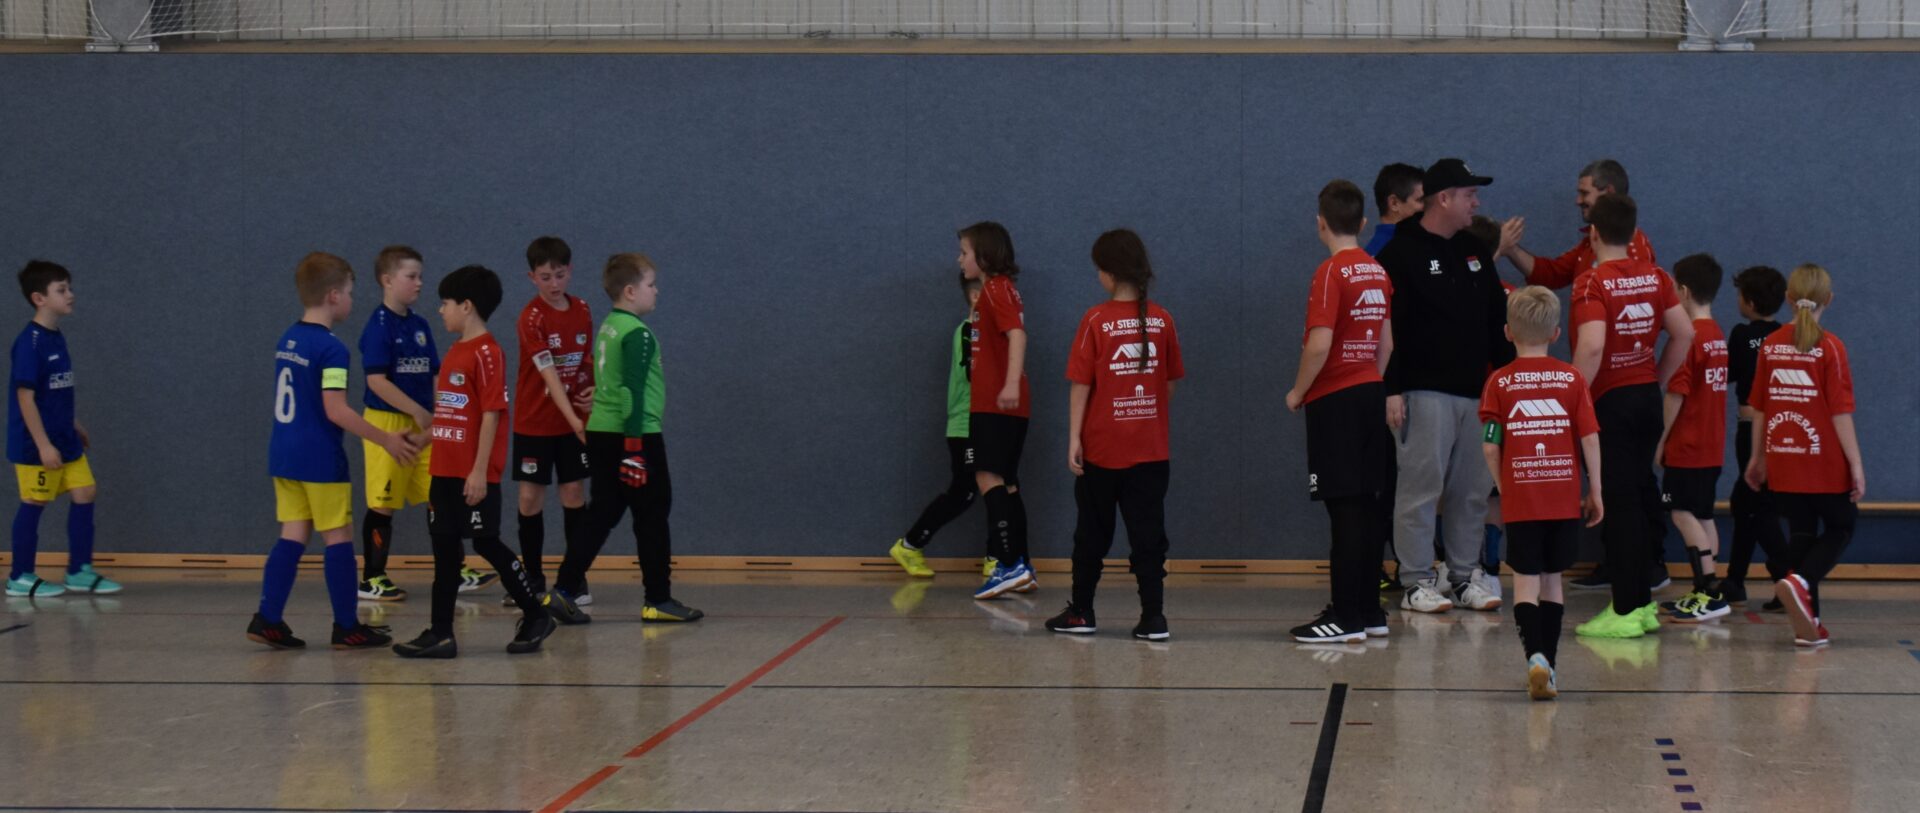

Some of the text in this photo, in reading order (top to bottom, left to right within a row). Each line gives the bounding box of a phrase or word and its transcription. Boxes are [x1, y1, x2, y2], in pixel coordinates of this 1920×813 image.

[1429, 260, 1440, 270] JF
[1341, 266, 1352, 278] SV
[1603, 279, 1615, 290] SV
[1102, 322, 1114, 333] SV
[1498, 371, 1575, 388] SV STERNBURG
[274, 366, 296, 424] 6
[1512, 459, 1573, 468] Kosmetiksalon
[1513, 468, 1573, 478] Am Schlosspark
[38, 472, 46, 486] 5
[384, 480, 391, 493] 4
